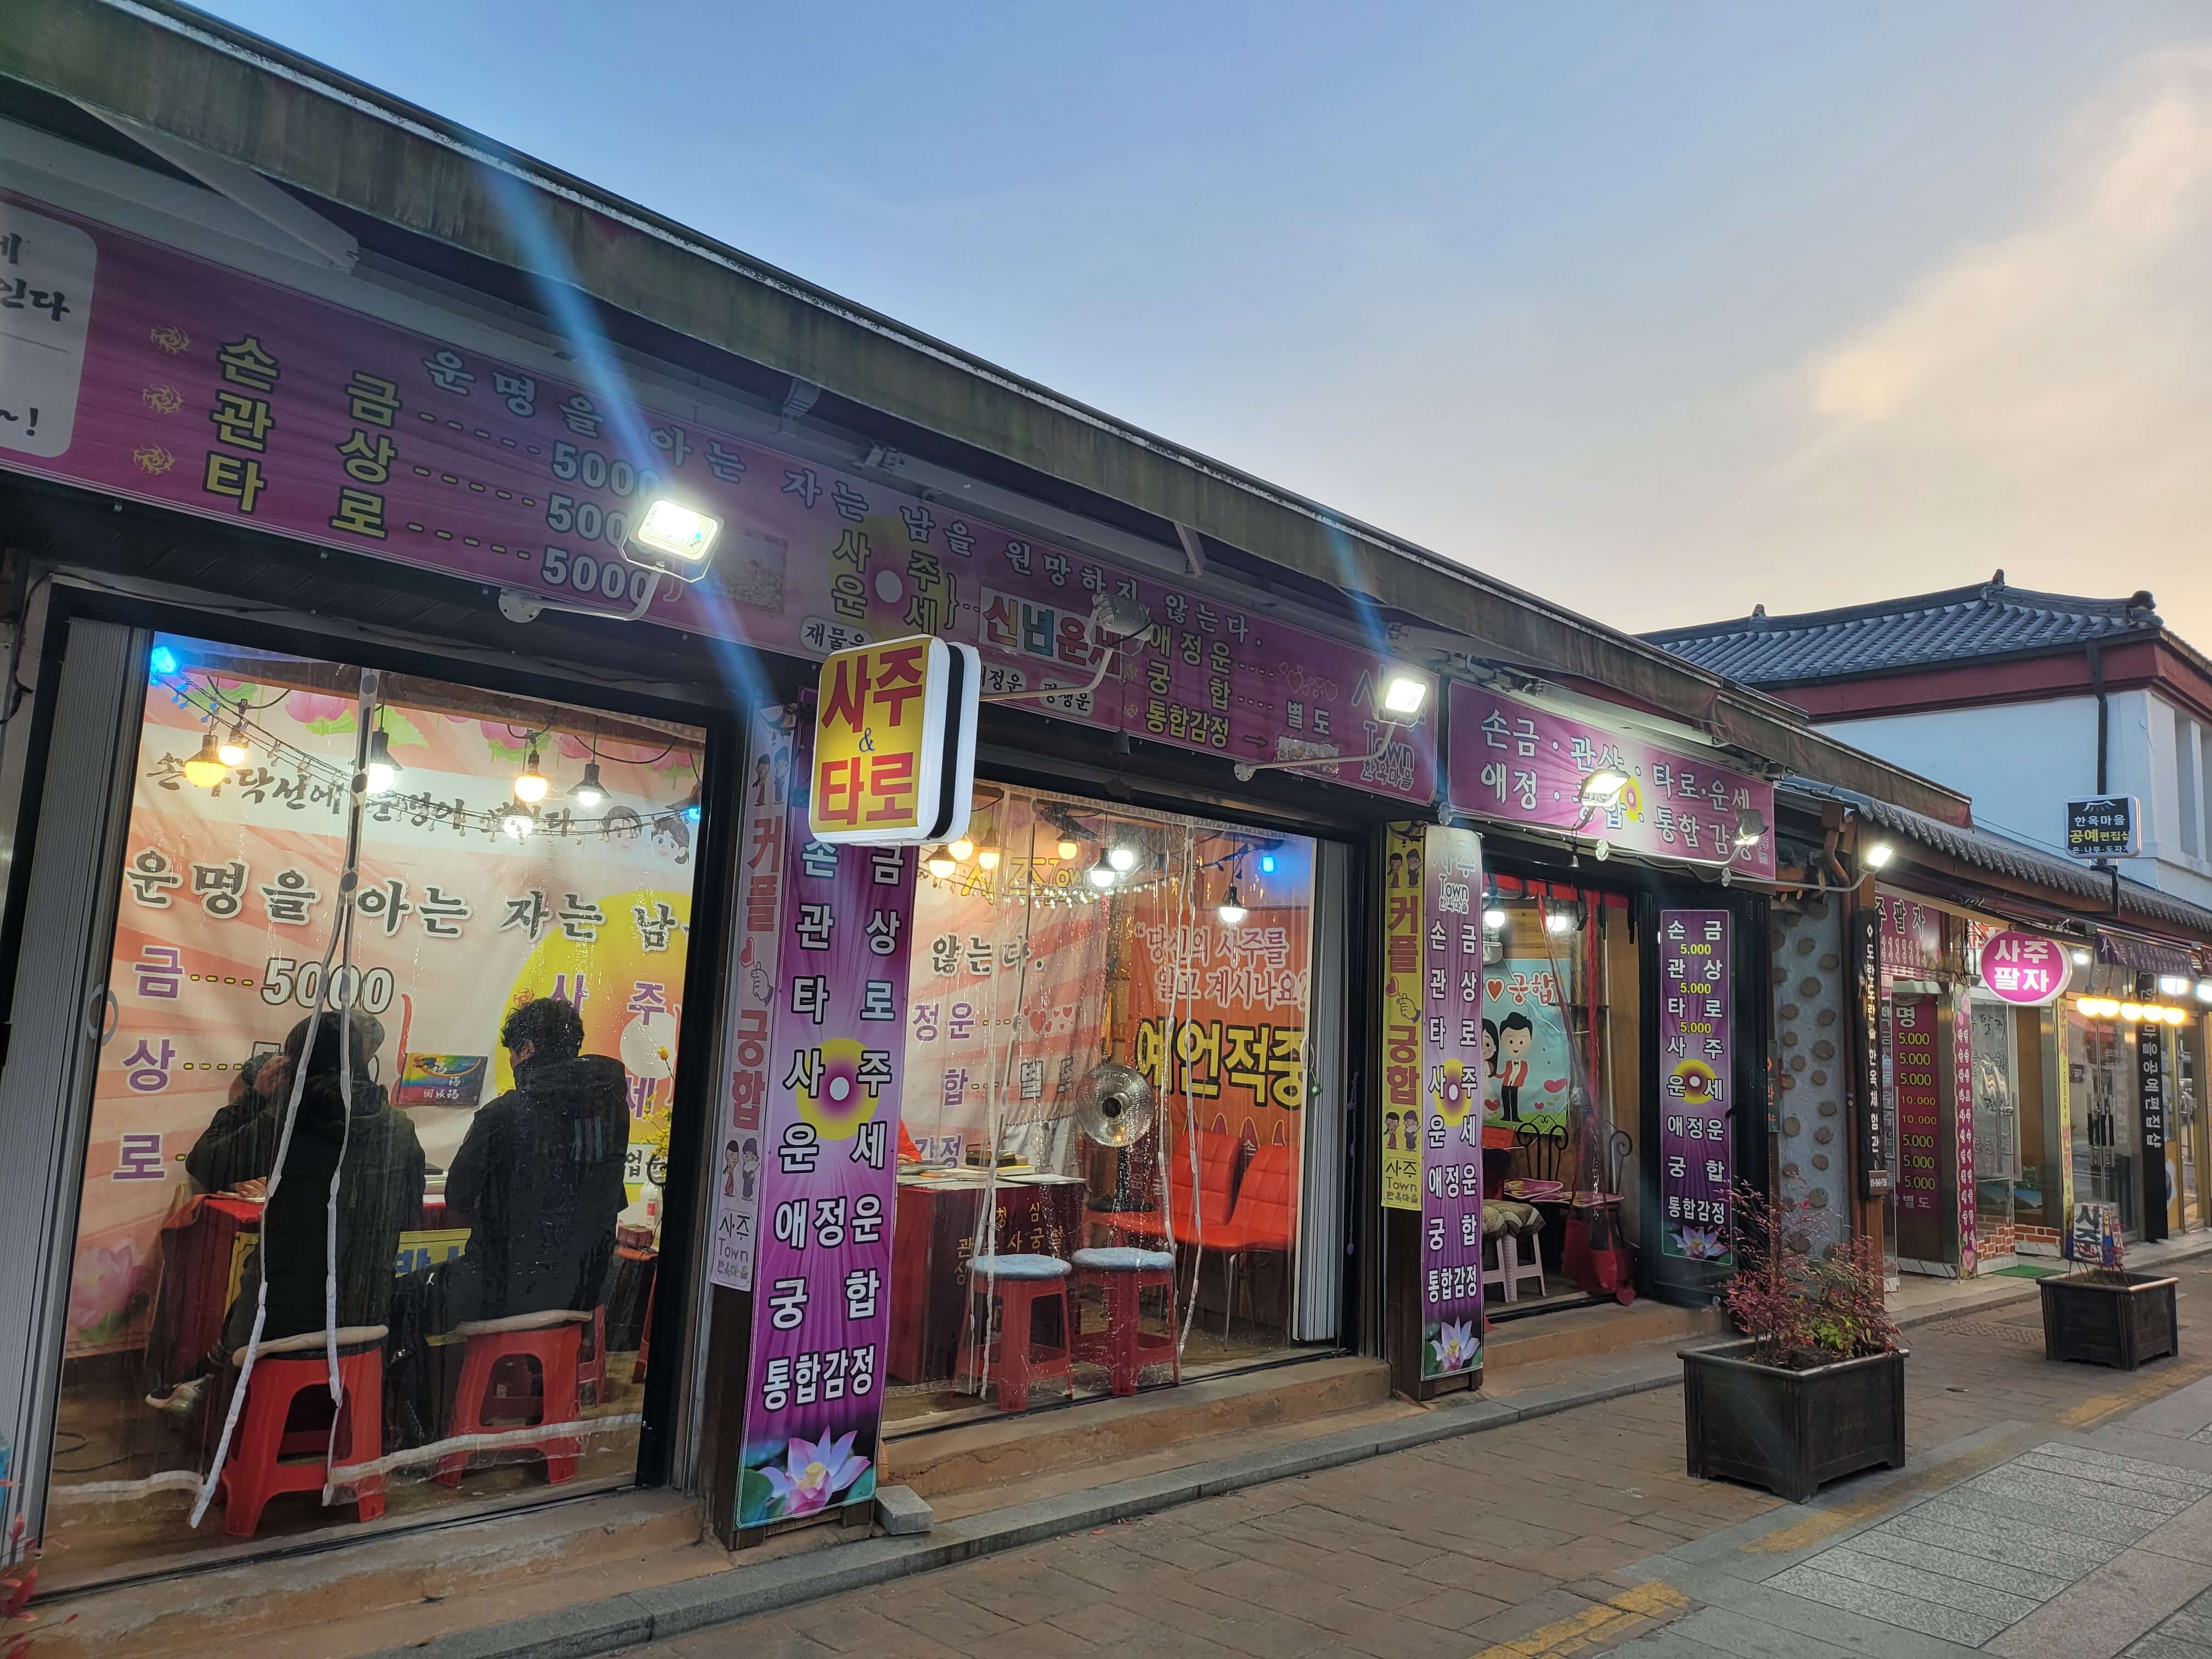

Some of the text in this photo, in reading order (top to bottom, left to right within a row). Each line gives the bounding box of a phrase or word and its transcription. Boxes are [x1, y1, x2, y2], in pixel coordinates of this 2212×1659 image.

[649, 424, 746, 483] 아는
[781, 468, 870, 522] 자는
[899, 505, 976, 558] 남을
[1004, 540, 1139, 602] 원망하지
[821, 645, 926, 733] 사주
[1481, 708, 1541, 757] 손금
[818, 751, 914, 826] 타로
[1360, 758, 1415, 792] 한옥마을
[1480, 761, 1538, 810] 애정
[2073, 814, 2126, 827] 한옥마을
[747, 815, 785, 933] 커플
[1438, 874, 1470, 901] Town
[126, 848, 691, 950] 운명을 아는 자는 남
[1387, 895, 1419, 974] 커플
[1679, 944, 1712, 956] 5,000
[1994, 939, 2049, 964] 사주
[1679, 982, 1712, 995] 5,000
[1993, 967, 2050, 993] 팔자
[1679, 1022, 1712, 1034] 5,000
[731, 1008, 768, 1131] 궁합
[1136, 1018, 1304, 1109] 예언적중
[1386, 1024, 1420, 1106] 궁합
[1667, 1115, 1725, 1142] 애정운
[1385, 1176, 1418, 1193] Town
[1428, 1164, 1477, 1198] 애정운
[774, 1195, 882, 1249] 애정운
[1667, 1195, 1725, 1225] 통합감정
[718, 1237, 749, 1263] Town
[1427, 1264, 1477, 1304] 통합감정
[763, 1345, 875, 1412] 통합감정
